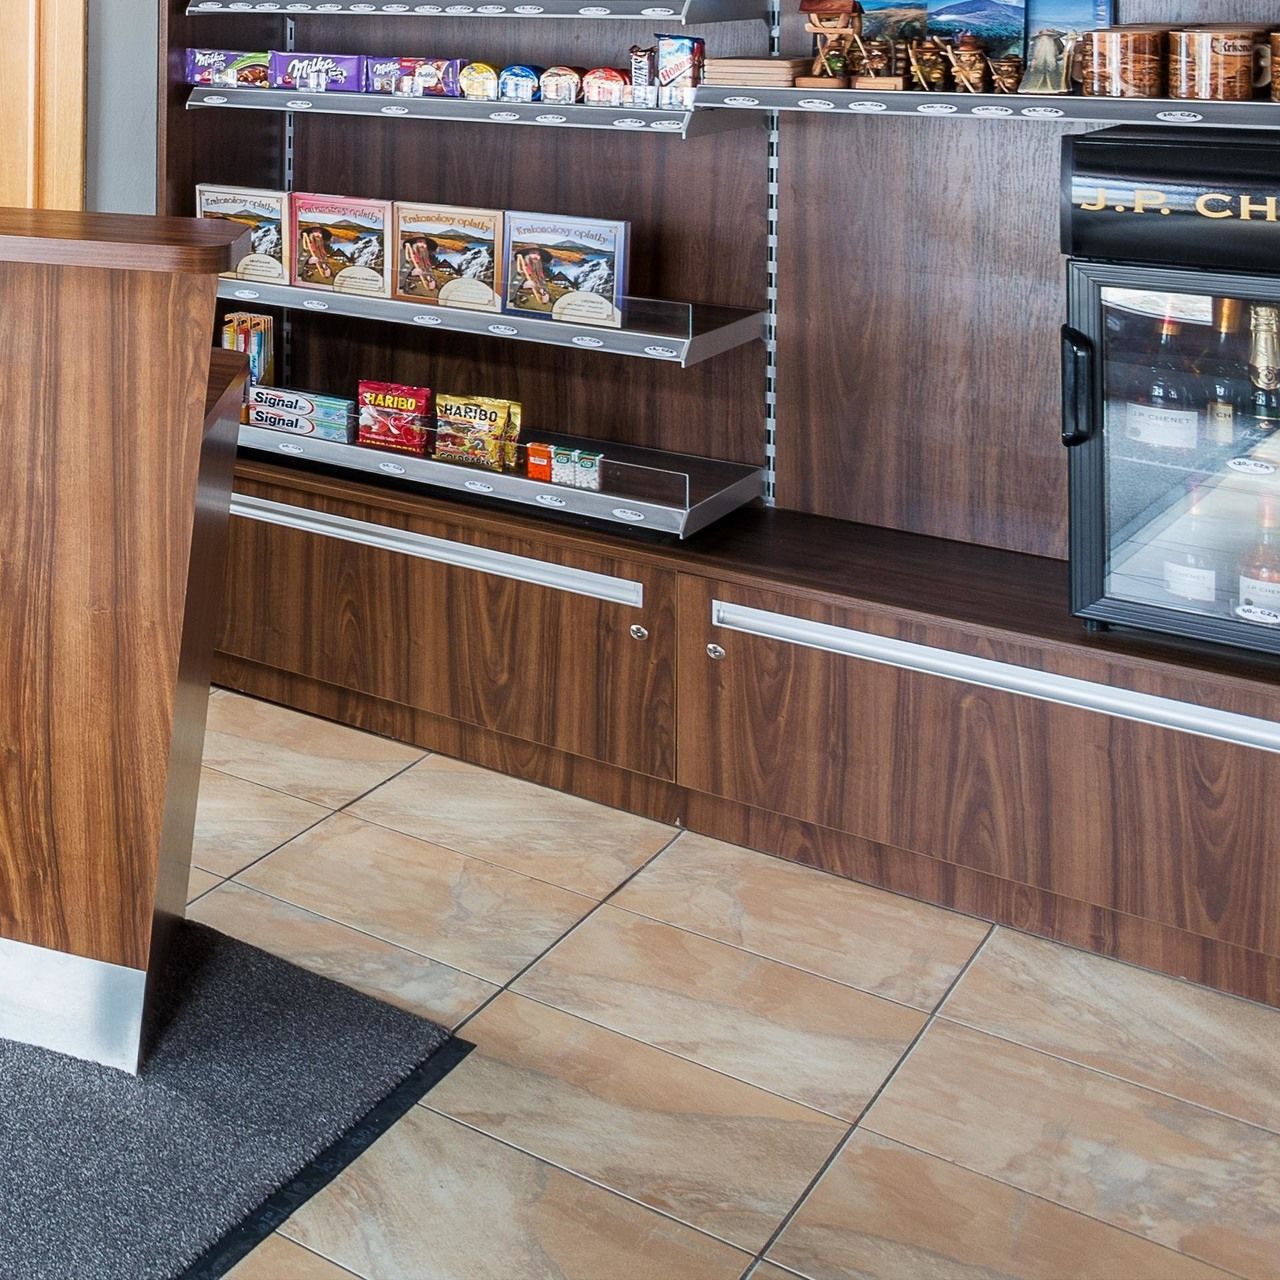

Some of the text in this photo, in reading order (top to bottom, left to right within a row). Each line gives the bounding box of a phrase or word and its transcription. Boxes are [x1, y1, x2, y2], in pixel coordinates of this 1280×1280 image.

[195, 52, 227, 67] Milka
[288, 57, 336, 79] Milka
[373, 62, 401, 75] Milka
[1080, 187, 1171, 215] J.P.
[254, 391, 299, 410] Signal
[367, 391, 417, 410] HARIBO
[254, 410, 299, 429] Signal
[443, 403, 498, 423] HARIBO
[1148, 413, 1192, 424] CHENET
